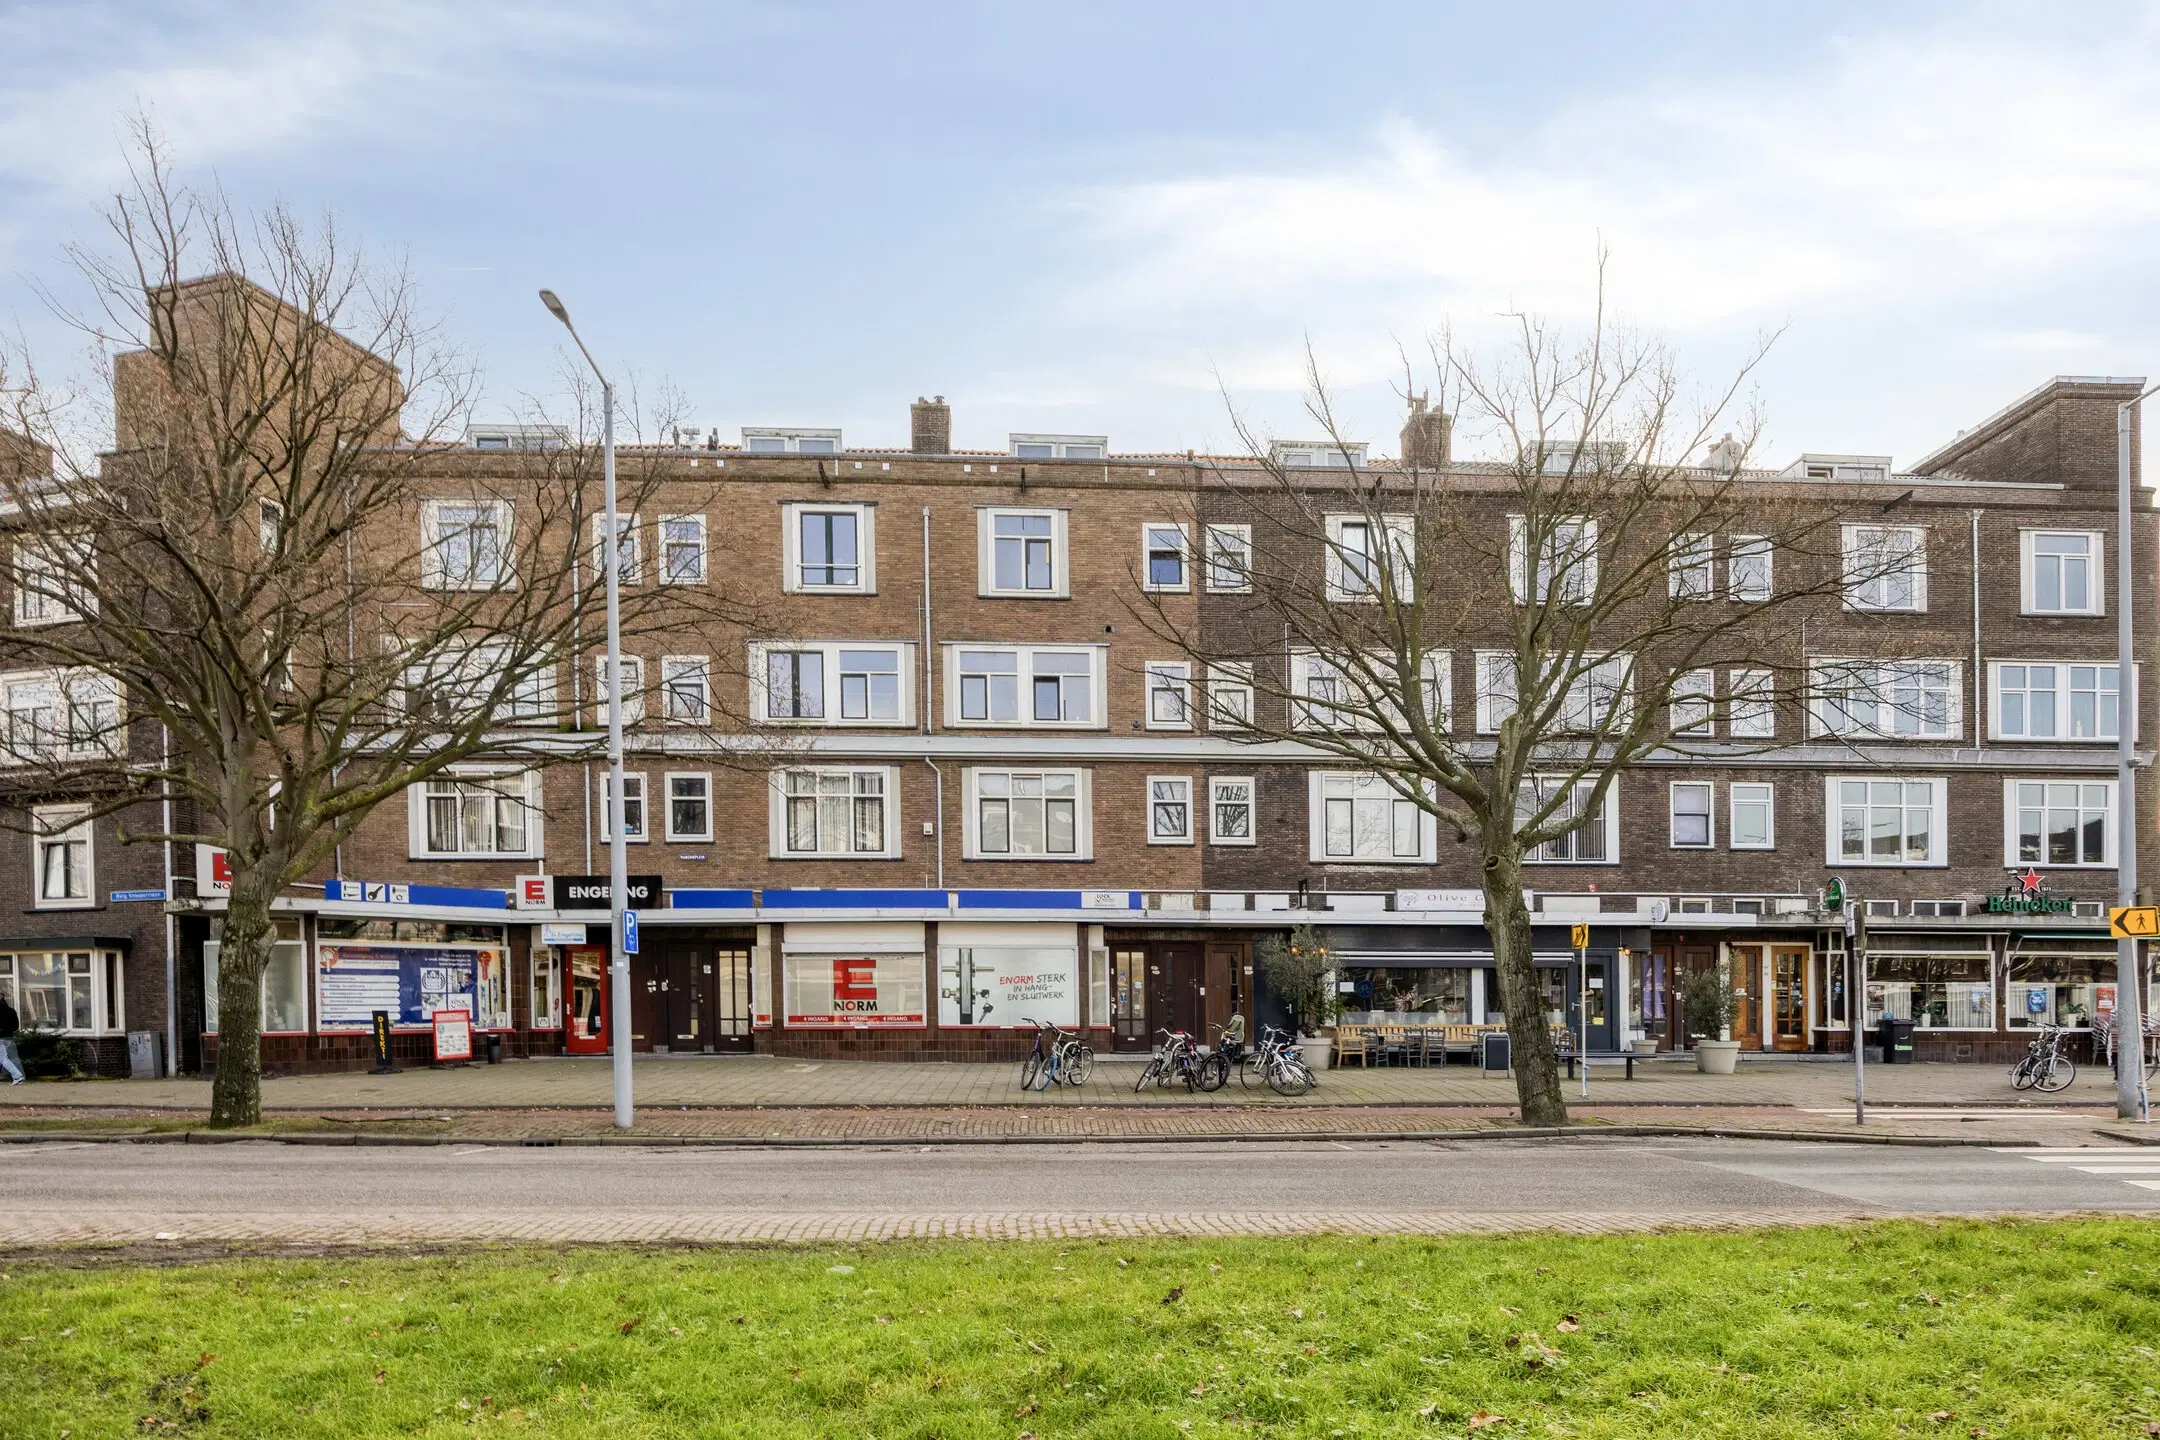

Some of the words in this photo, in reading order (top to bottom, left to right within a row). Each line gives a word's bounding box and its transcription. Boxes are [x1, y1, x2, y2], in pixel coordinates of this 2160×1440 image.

[524, 880, 545, 899] E
[569, 885, 649, 898] ENGENG
[1427, 894, 1468, 902] Olive
[1988, 896, 2074, 912] Heineken
[626, 912, 635, 935] P
[833, 959, 877, 1000] E
[1000, 975, 1035, 985] ENORM
[1036, 972, 1066, 984] STERK
[1013, 985, 1022, 993] IN
[1024, 984, 1053, 992] HANG-
[1007, 993, 1019, 1001] EN
[1020, 991, 1065, 1001] SLUITWERK
[833, 1000, 878, 1011] NORM
